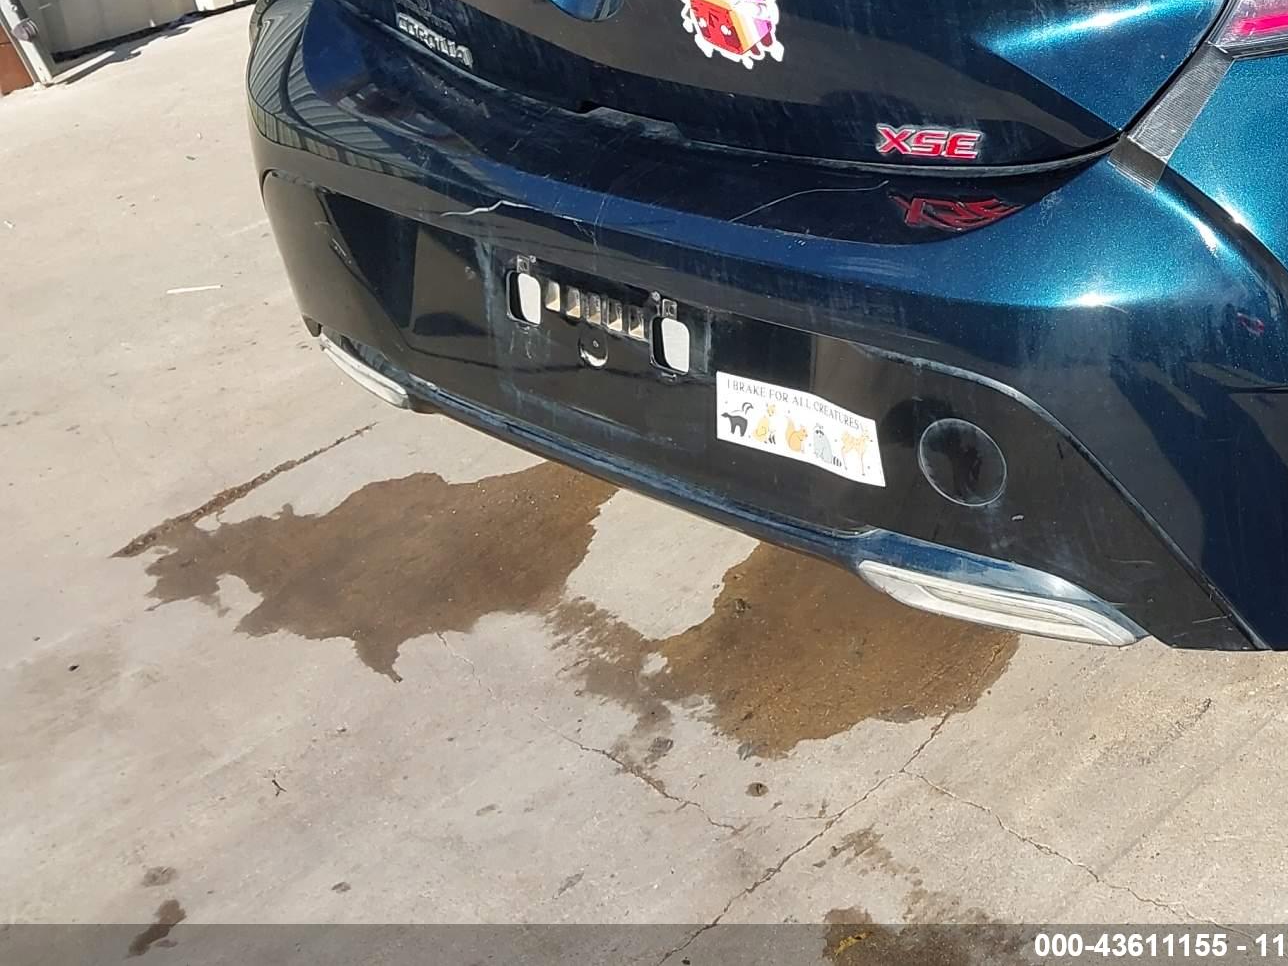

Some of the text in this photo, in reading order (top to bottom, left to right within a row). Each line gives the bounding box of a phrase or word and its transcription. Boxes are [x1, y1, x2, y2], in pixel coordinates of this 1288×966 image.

[877, 123, 984, 160] XSE
[733, 379, 766, 395] BRAKE
[769, 389, 789, 403] FOR
[792, 396, 811, 409] ALL
